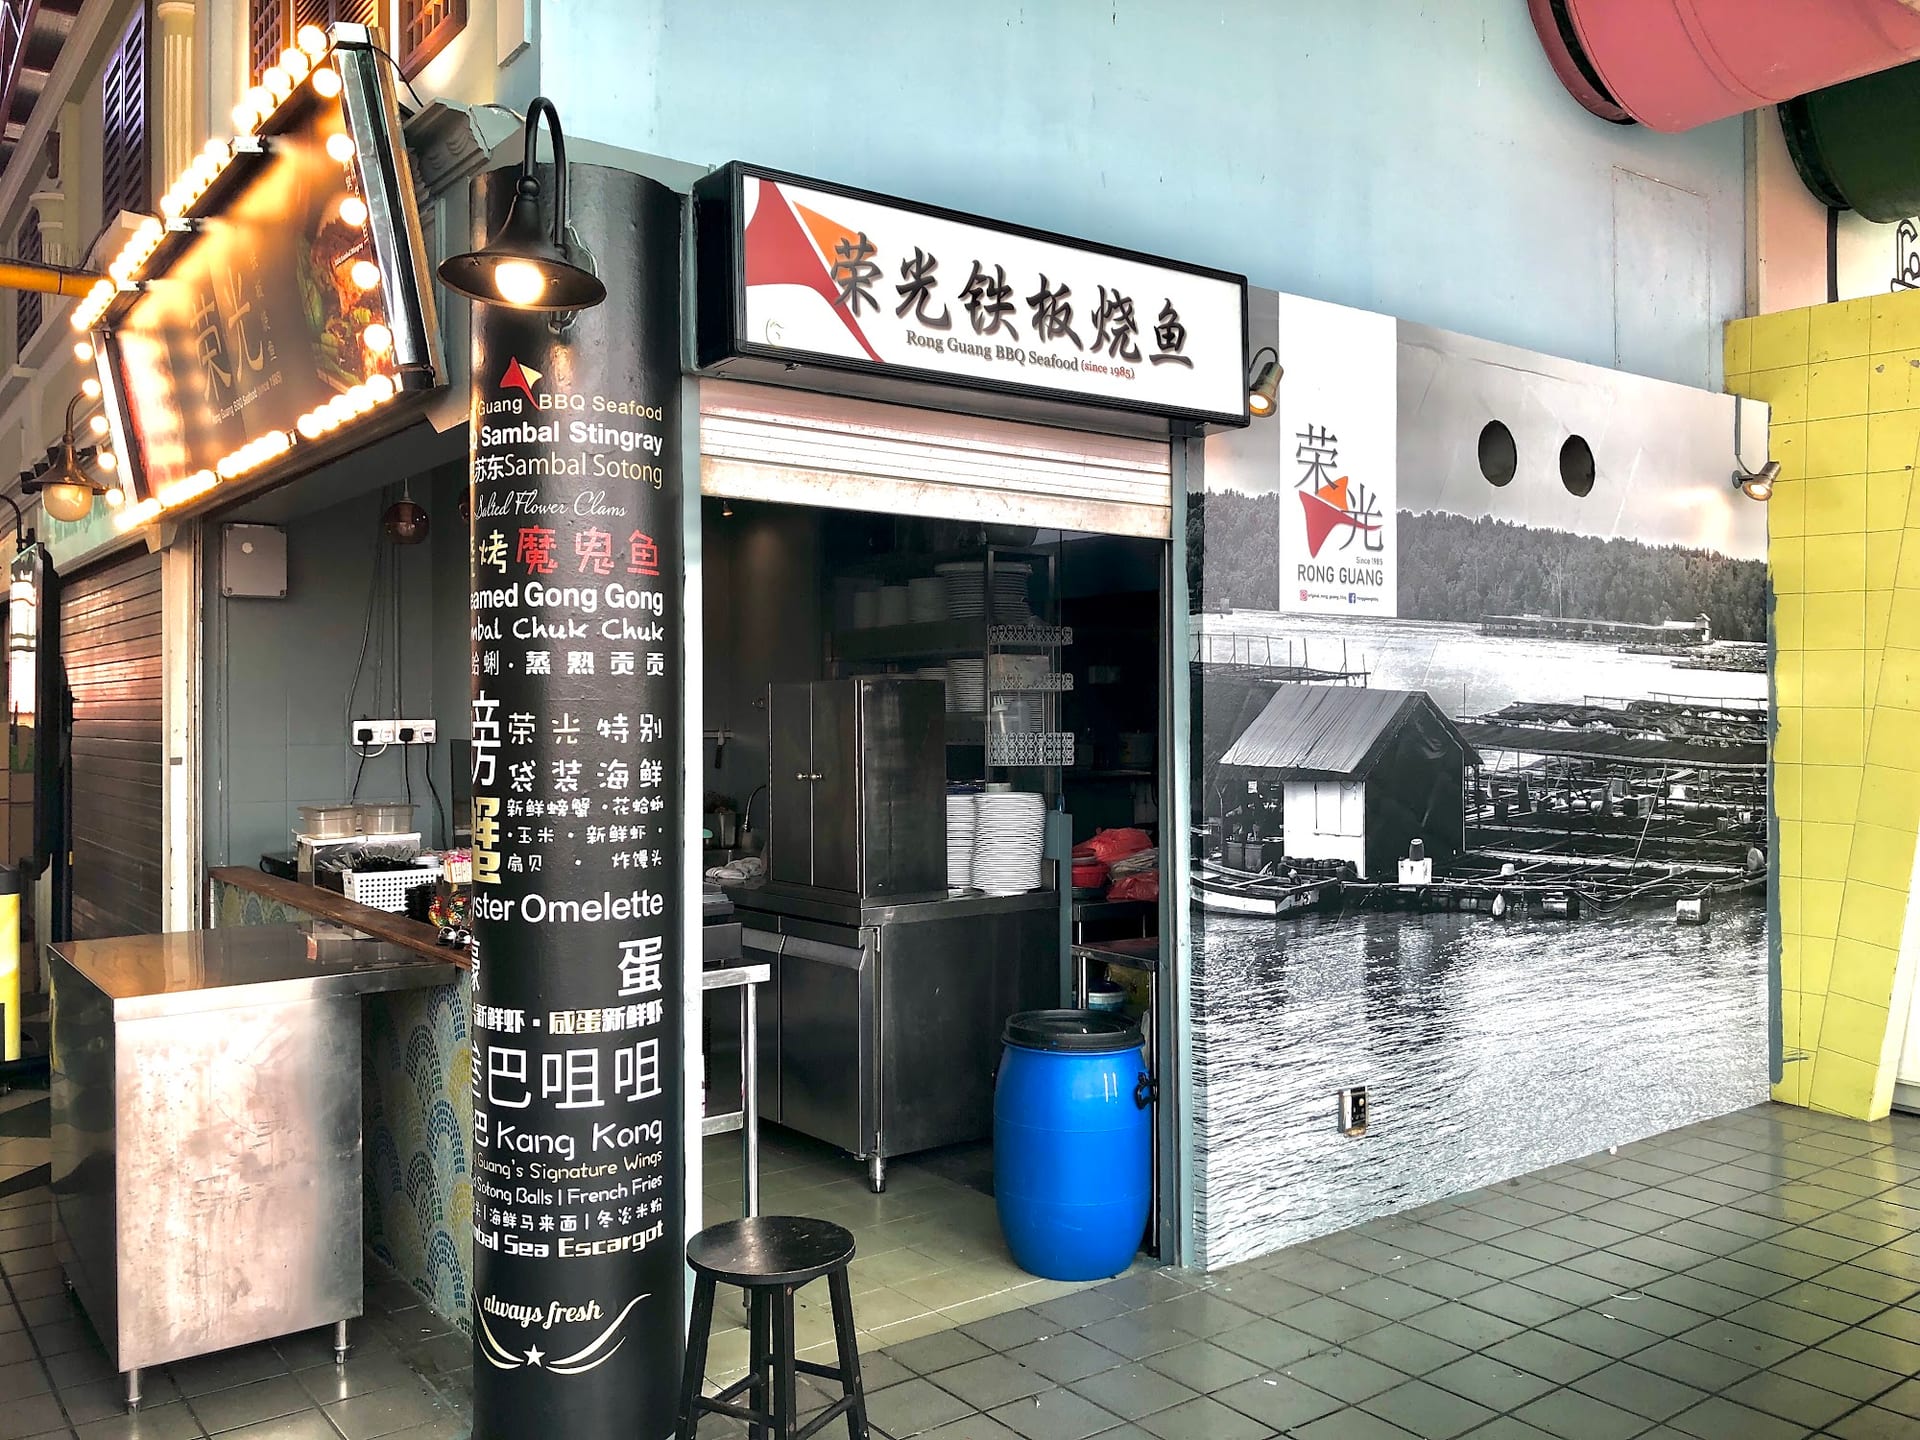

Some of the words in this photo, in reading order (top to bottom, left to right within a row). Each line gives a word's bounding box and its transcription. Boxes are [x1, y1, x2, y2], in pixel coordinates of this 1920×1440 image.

[829, 232, 1194, 369] 荣光铁板烧鱼
[906, 330, 944, 351] Rong
[947, 338, 992, 361] Guang
[996, 345, 1026, 364] BBQ
[1029, 353, 1078, 372] Seafood
[1081, 359, 1108, 374] (since
[1110, 366, 1136, 380] 1985)
[478, 398, 523, 416] Guang
[539, 394, 586, 411] BBQ
[592, 396, 663, 422] Seafood
[481, 421, 560, 447] Sambal
[569, 421, 663, 456] Stingray
[505, 452, 586, 477] Sambal
[593, 454, 663, 489] Sotong
[515, 488, 569, 515] Flower
[574, 490, 628, 517] Clams
[1298, 564, 1335, 584] RONG
[1339, 567, 1383, 586] GUANG
[525, 581, 597, 613] Gong
[605, 583, 664, 616] Gong
[512, 618, 590, 639] Chuk
[601, 617, 664, 641] Chuk
[508, 712, 663, 745] 荣光特别
[508, 758, 663, 793] 袋装海鲜
[507, 853, 542, 873] 扇贝
[611, 849, 662, 869] 炸馒头
[521, 888, 664, 923] Omelette
[617, 936, 663, 997] 蛋
[497, 1121, 575, 1160] Kang
[592, 1119, 663, 1151] Kong
[477, 1152, 523, 1179] Guang's
[530, 1162, 618, 1183] Signature
[624, 1150, 662, 1171] Wings
[478, 1175, 512, 1205] Sotong
[516, 1187, 553, 1206] Balls
[567, 1183, 628, 1205] French
[632, 1174, 663, 1196] Fries
[489, 1207, 577, 1232] 海鲜马来面
[504, 1234, 550, 1258] Sea
[558, 1220, 664, 1258] Escargot
[484, 1294, 544, 1329] always
[542, 1299, 604, 1330] fresh
